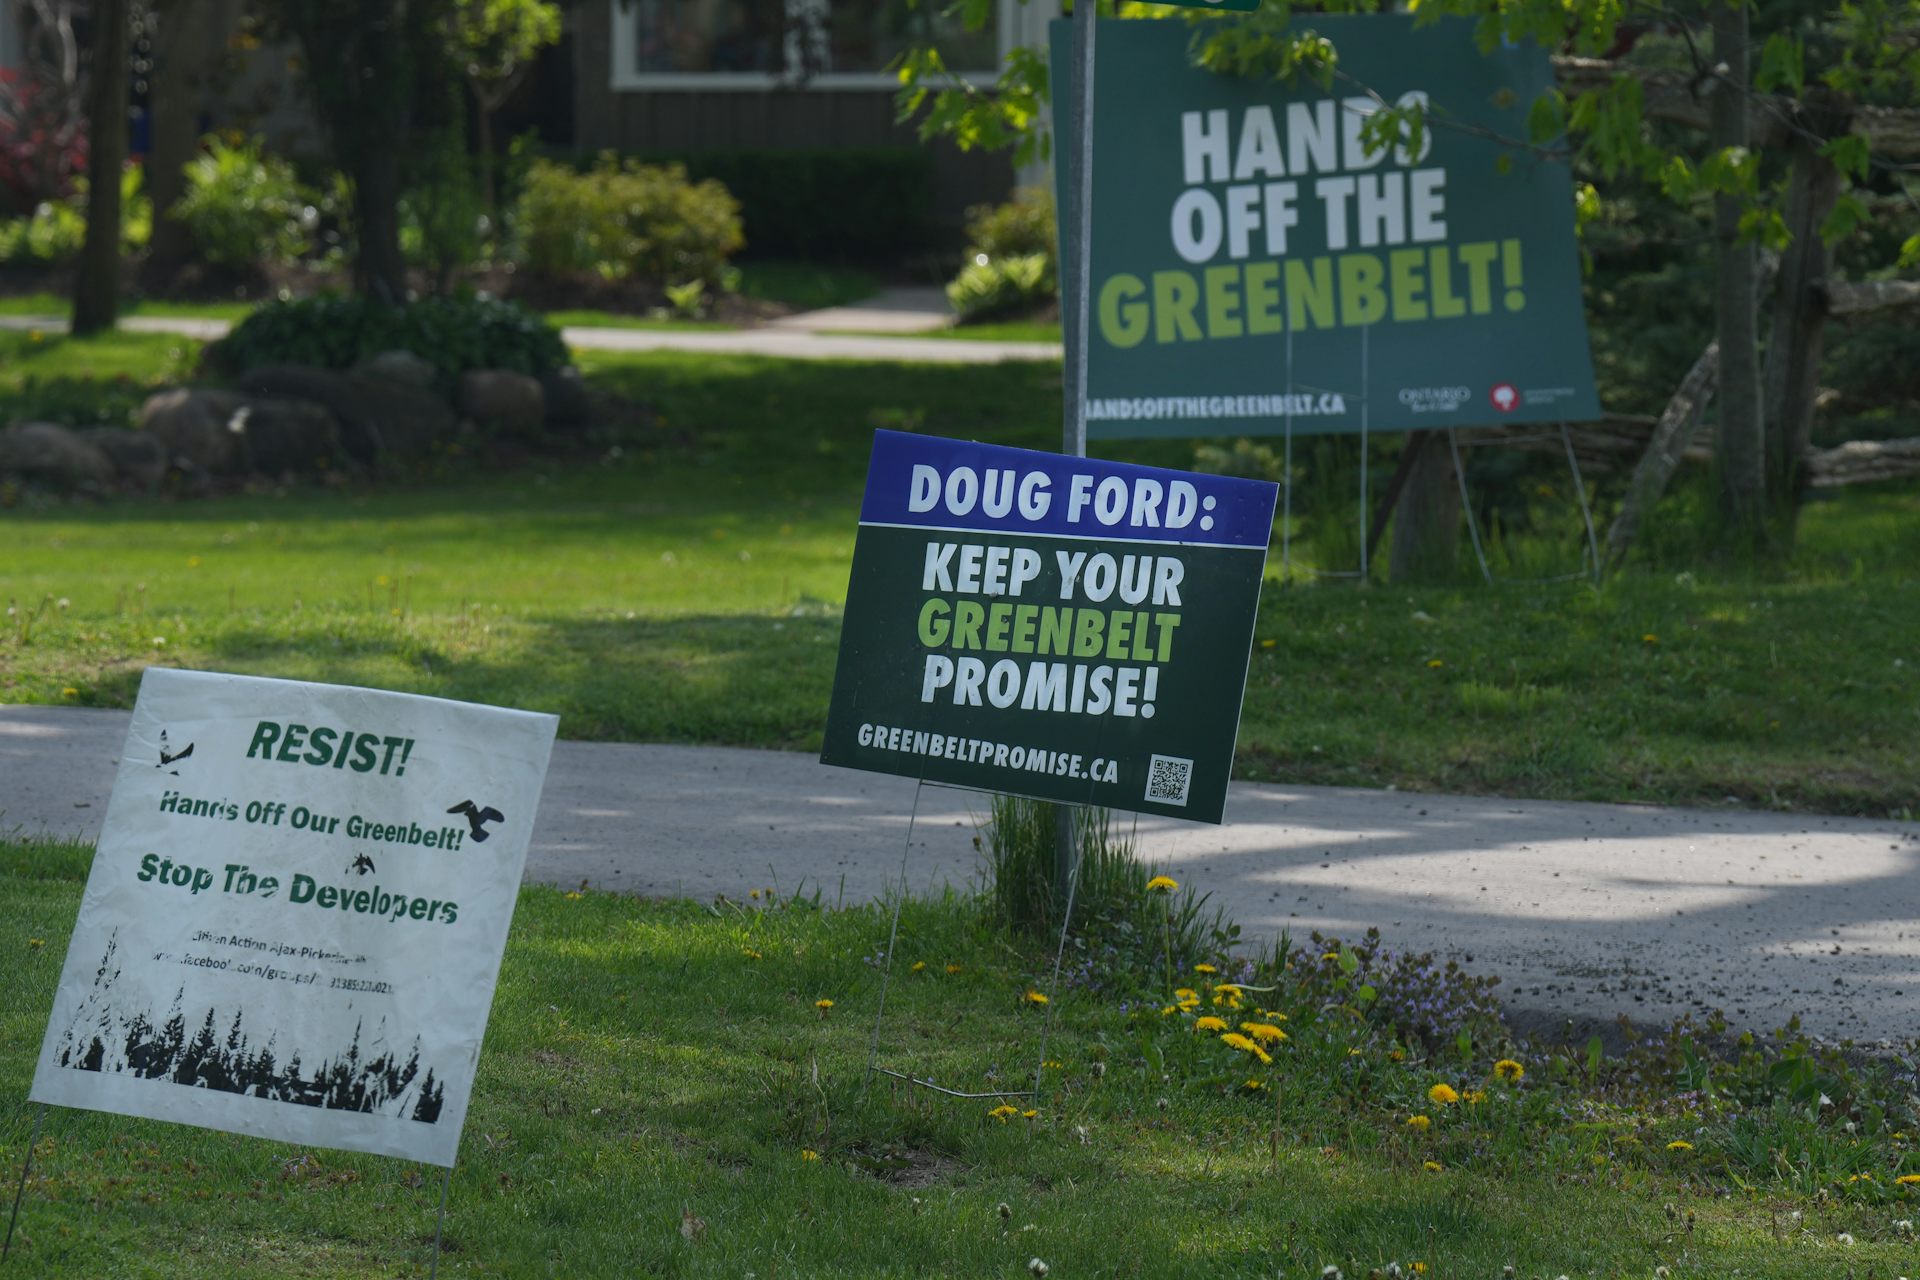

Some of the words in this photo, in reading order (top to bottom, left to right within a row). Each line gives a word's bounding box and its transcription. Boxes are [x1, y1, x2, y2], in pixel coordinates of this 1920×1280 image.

[1181, 91, 1432, 185] HANDS
[1170, 181, 1299, 264] OFF
[1315, 168, 1448, 250] THE
[1098, 239, 1526, 349] GREENBELT!
[908, 464, 1052, 521] DOUG
[1066, 474, 1218, 531] FORD:
[921, 541, 1042, 597] KEEP
[1055, 550, 1186, 607] YOUR
[917, 598, 1182, 663] GREENBELT
[920, 654, 1160, 719] PROMISE!
[246, 720, 415, 777] RESIST!
[857, 722, 1119, 785] GREENBELTPROMISE.CA
[160, 790, 239, 821] Hands
[245, 800, 287, 826] Off
[290, 806, 340, 834] Our
[346, 814, 465, 851] Greenbelt!
[136, 852, 214, 895] Stop
[223, 863, 279, 898] The
[288, 873, 459, 924] Developers
[229, 935, 267, 951] Action
